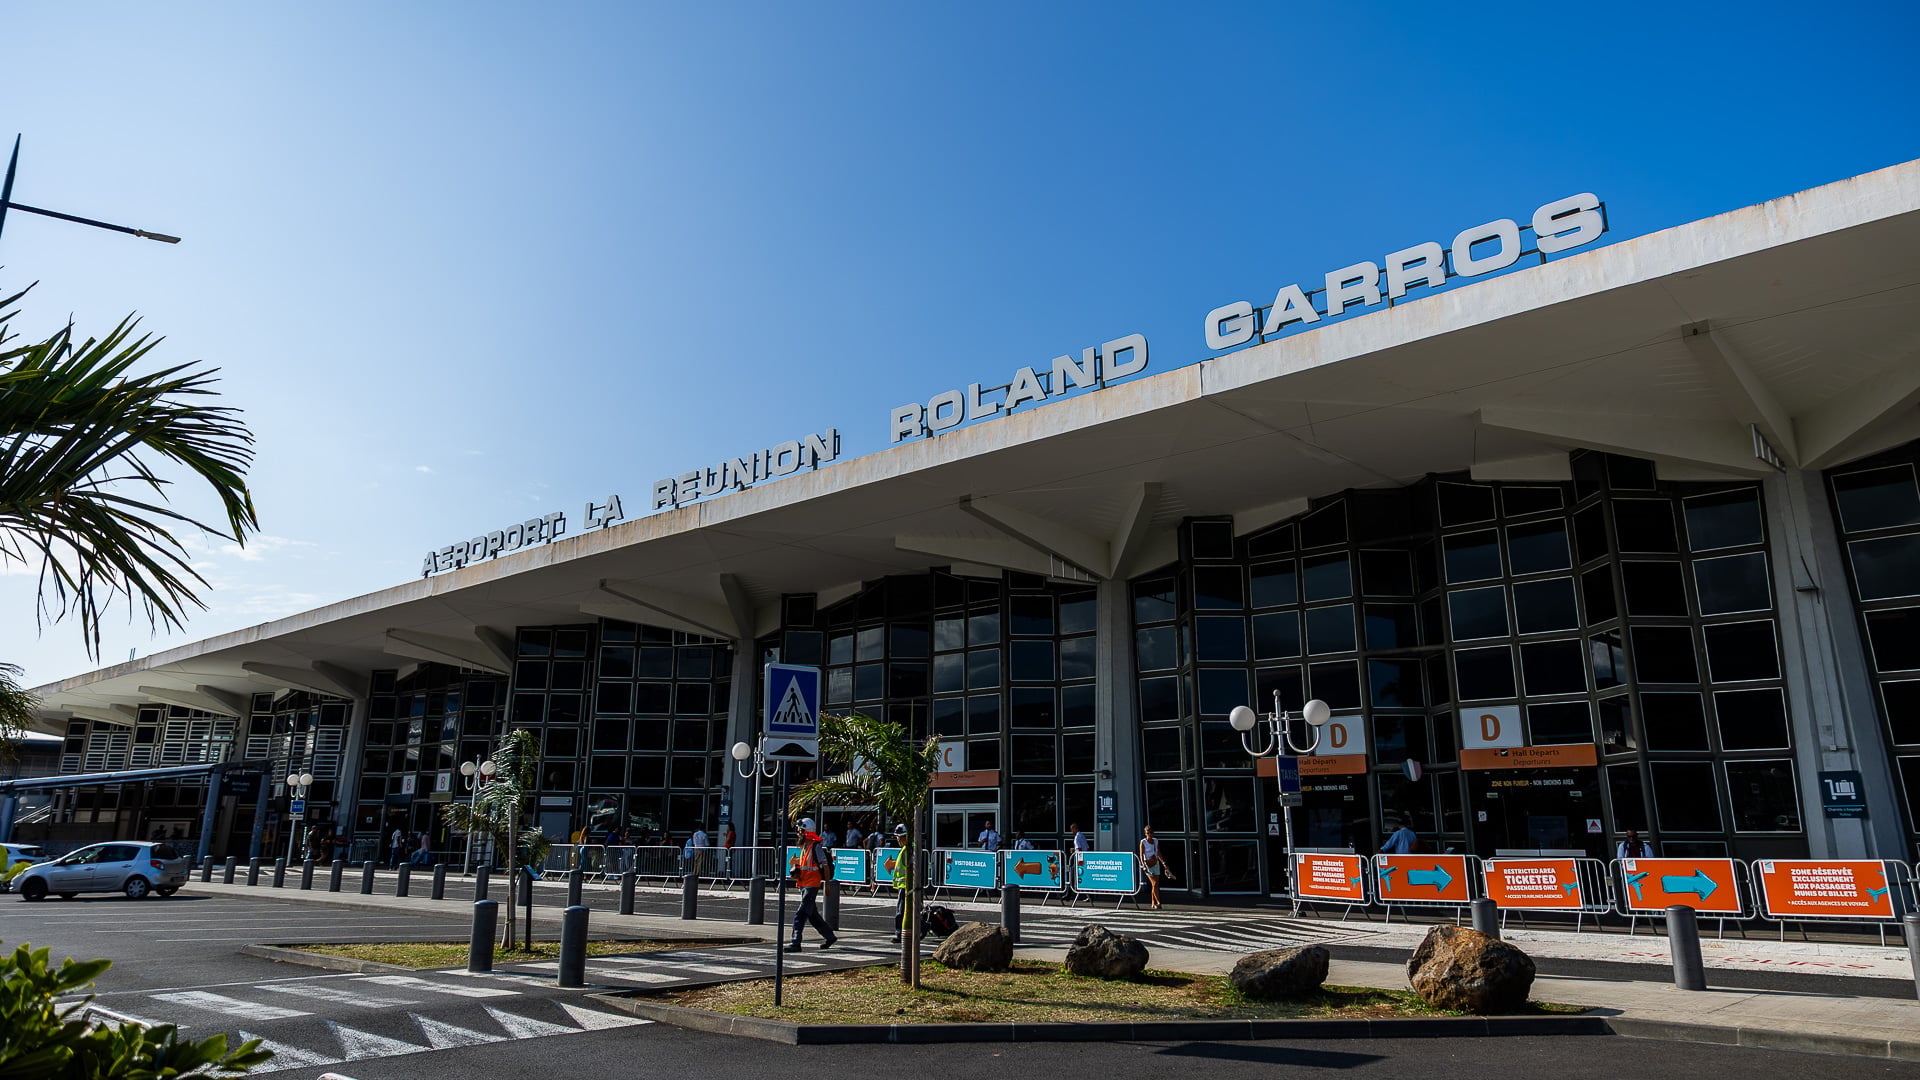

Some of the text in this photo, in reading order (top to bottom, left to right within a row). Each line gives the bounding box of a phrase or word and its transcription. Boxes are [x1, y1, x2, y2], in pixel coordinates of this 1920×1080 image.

[422, 192, 1603, 577] AEROPORT LA REUNION ROLAND GARROS
[1480, 714, 1500, 741] D
[1330, 723, 1347, 748] D
[944, 747, 952, 767] C
[1512, 749, 1528, 757] Hall
[1513, 758, 1551, 767] Departures
[1280, 769, 1298, 781] TAXIS
[406, 779, 412, 791] B
[440, 776, 446, 789] B
[1790, 866, 1853, 876] ZONE RÉSERVÉE
[1504, 874, 1557, 885] TICKETED
[1791, 875, 1854, 883] EXCLUSIVEMENT
[1829, 890, 1858, 898] BILLETS
